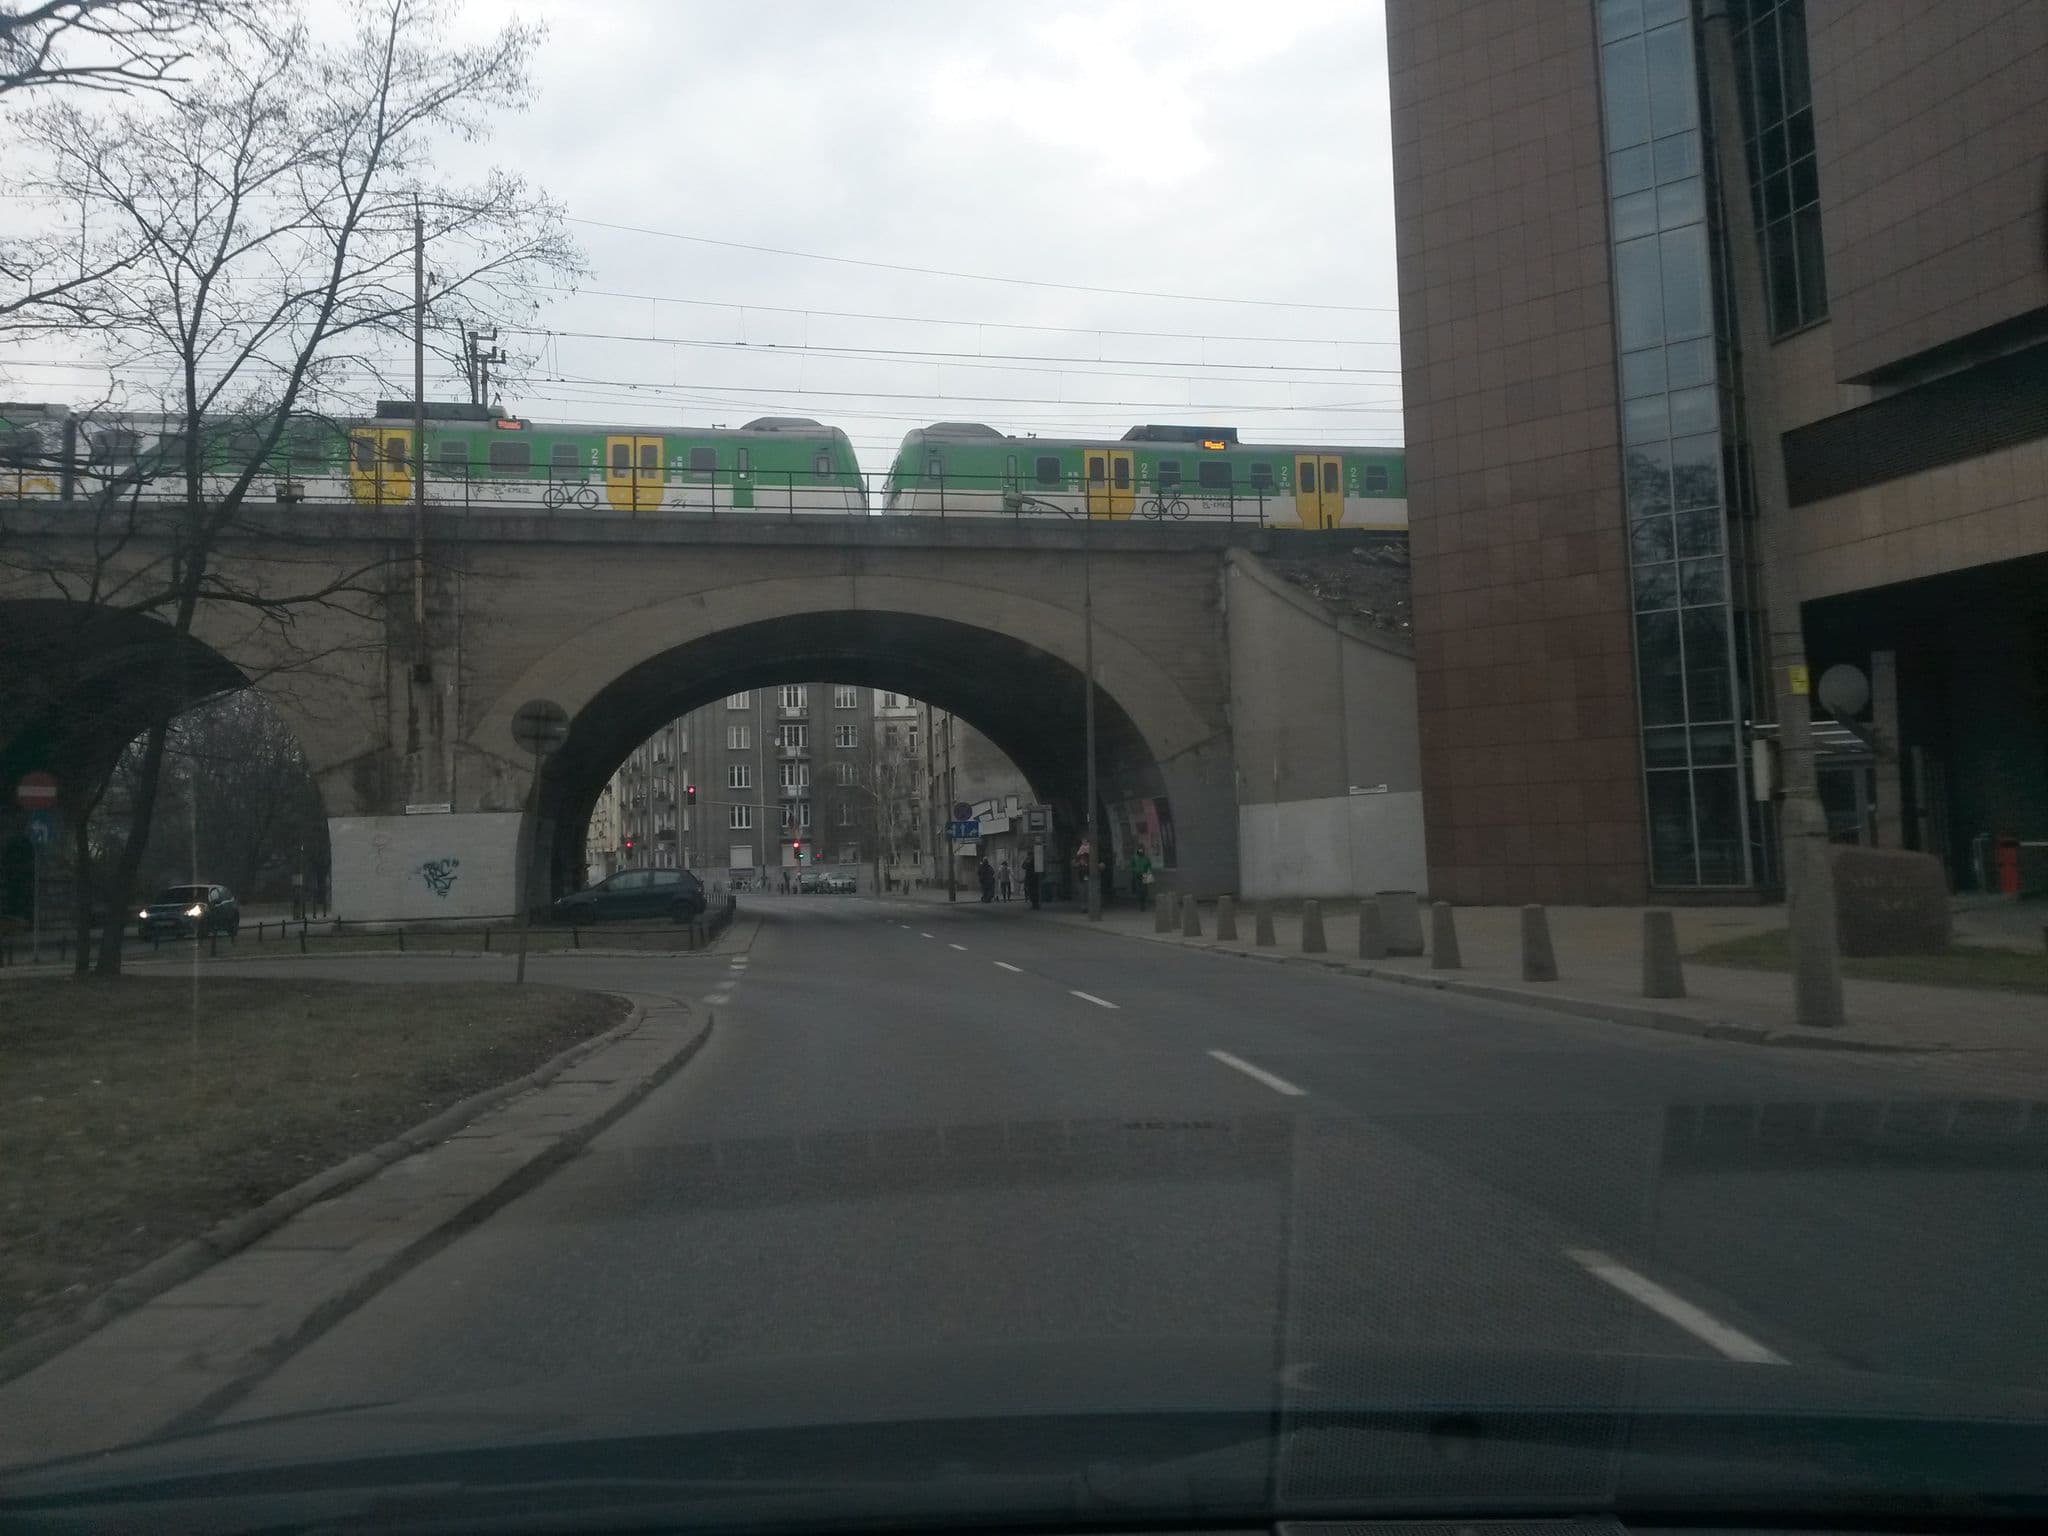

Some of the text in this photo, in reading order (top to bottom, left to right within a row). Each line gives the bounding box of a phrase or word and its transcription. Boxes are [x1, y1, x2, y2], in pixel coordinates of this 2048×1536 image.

[591, 448, 599, 459] 2
[1141, 463, 1148, 473] 2
[1281, 466, 1288, 476] 2
[1351, 467, 1357, 477] 2
